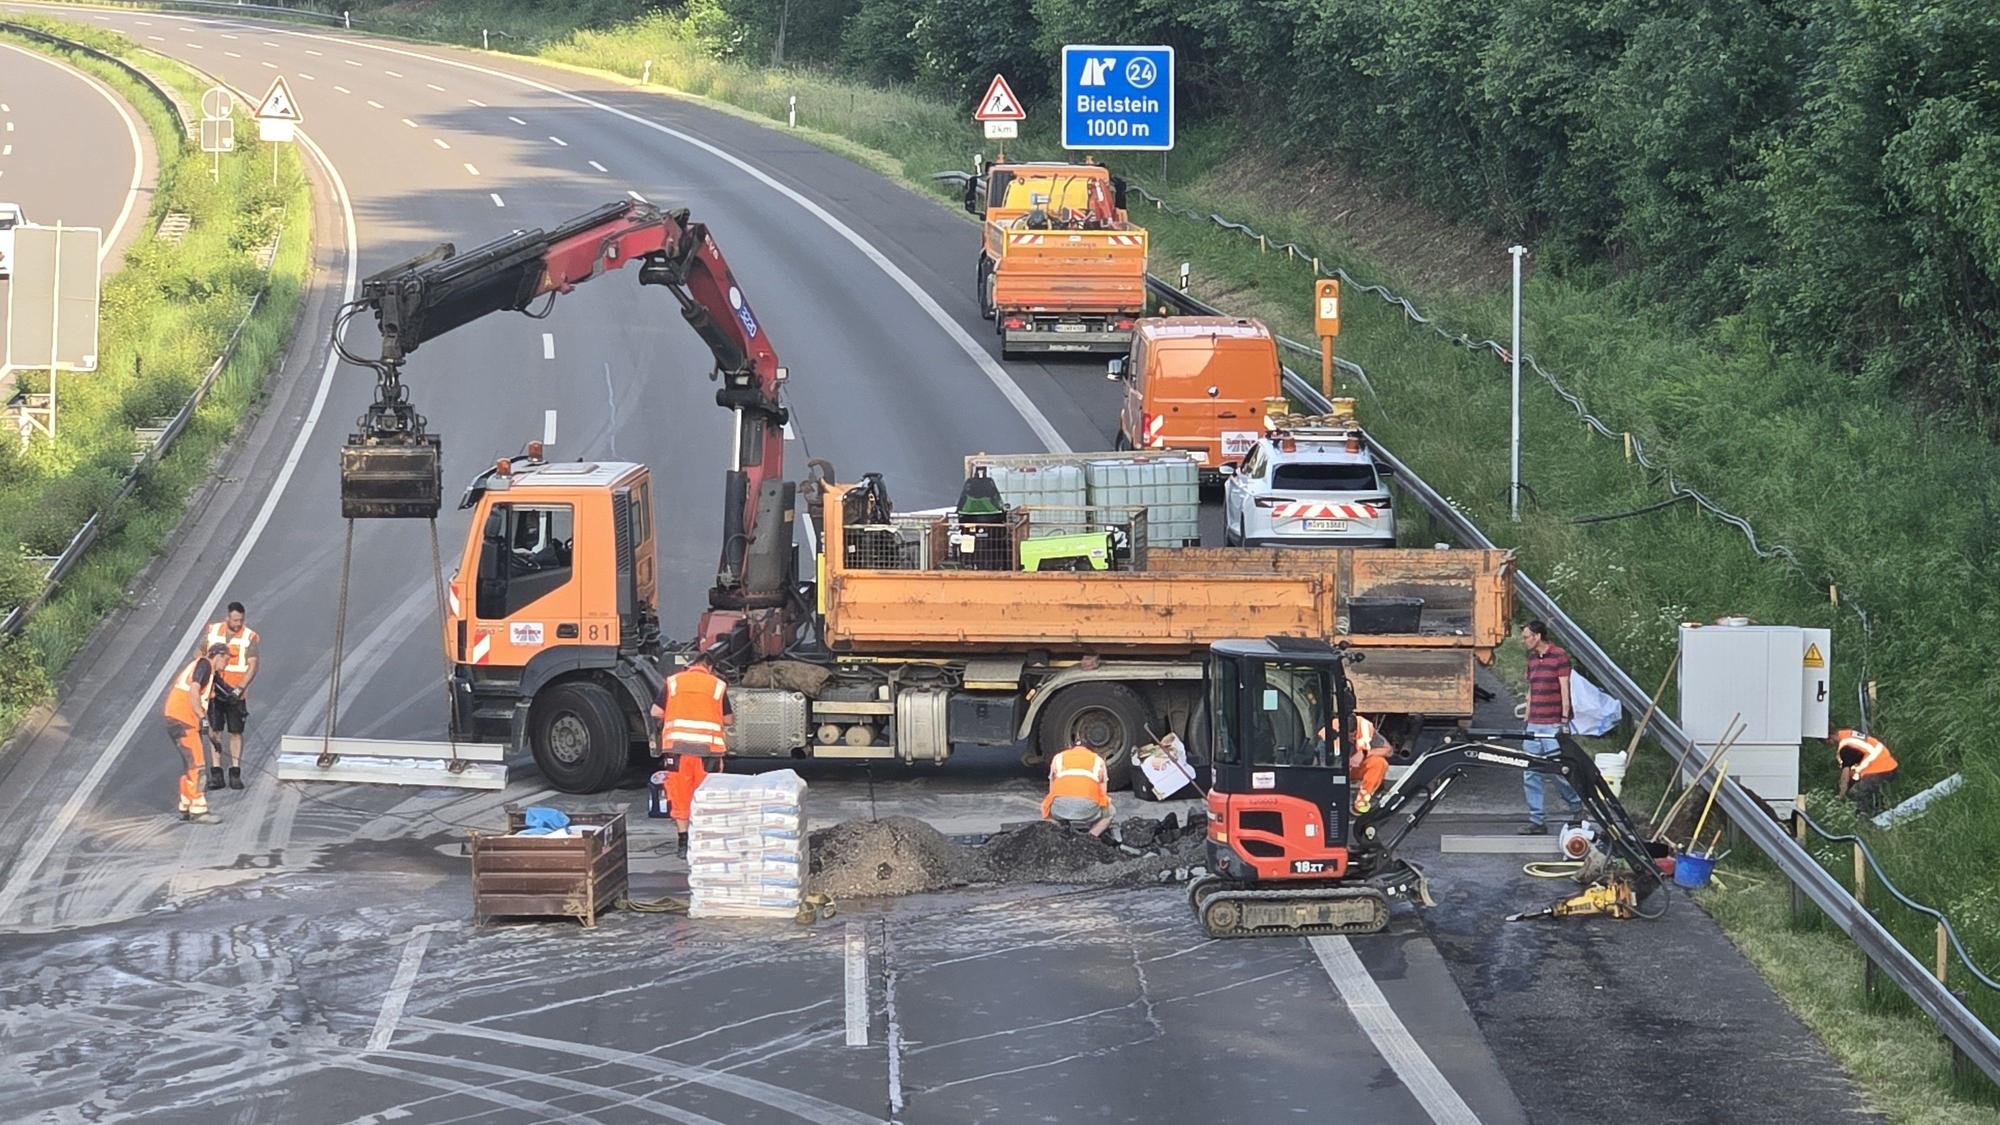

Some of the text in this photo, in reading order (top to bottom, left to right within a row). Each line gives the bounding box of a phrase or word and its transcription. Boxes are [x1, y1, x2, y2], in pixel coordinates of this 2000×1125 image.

[1130, 63, 1152, 81] 24
[1077, 95, 1159, 112] Bielstein
[1086, 119, 1150, 136] 1000 m
[589, 624, 609, 641] 81
